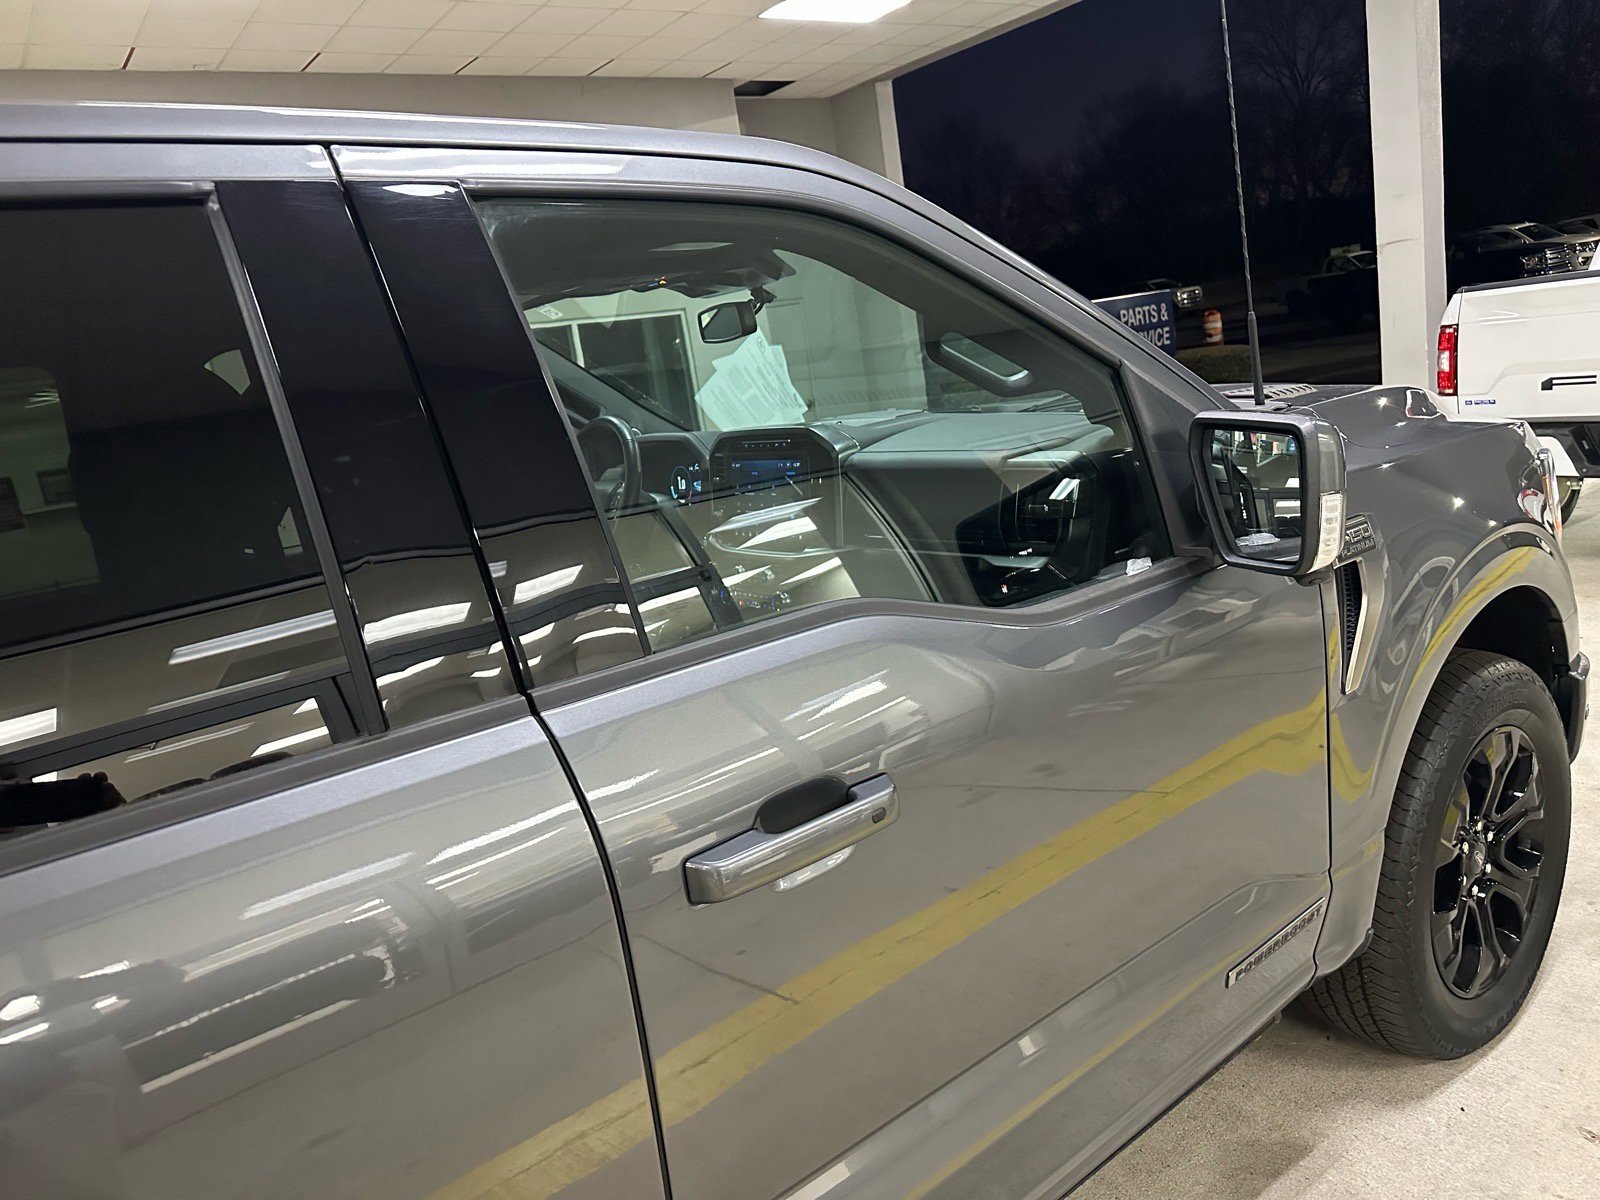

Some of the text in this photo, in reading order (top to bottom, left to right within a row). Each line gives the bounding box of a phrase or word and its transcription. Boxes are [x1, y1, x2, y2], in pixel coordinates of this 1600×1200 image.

[1119, 302, 1169, 327] PARTS &
[1138, 326, 1171, 346] VICE
[1341, 539, 1374, 557] PLATINUM
[1235, 905, 1323, 982] POWERBOOST
